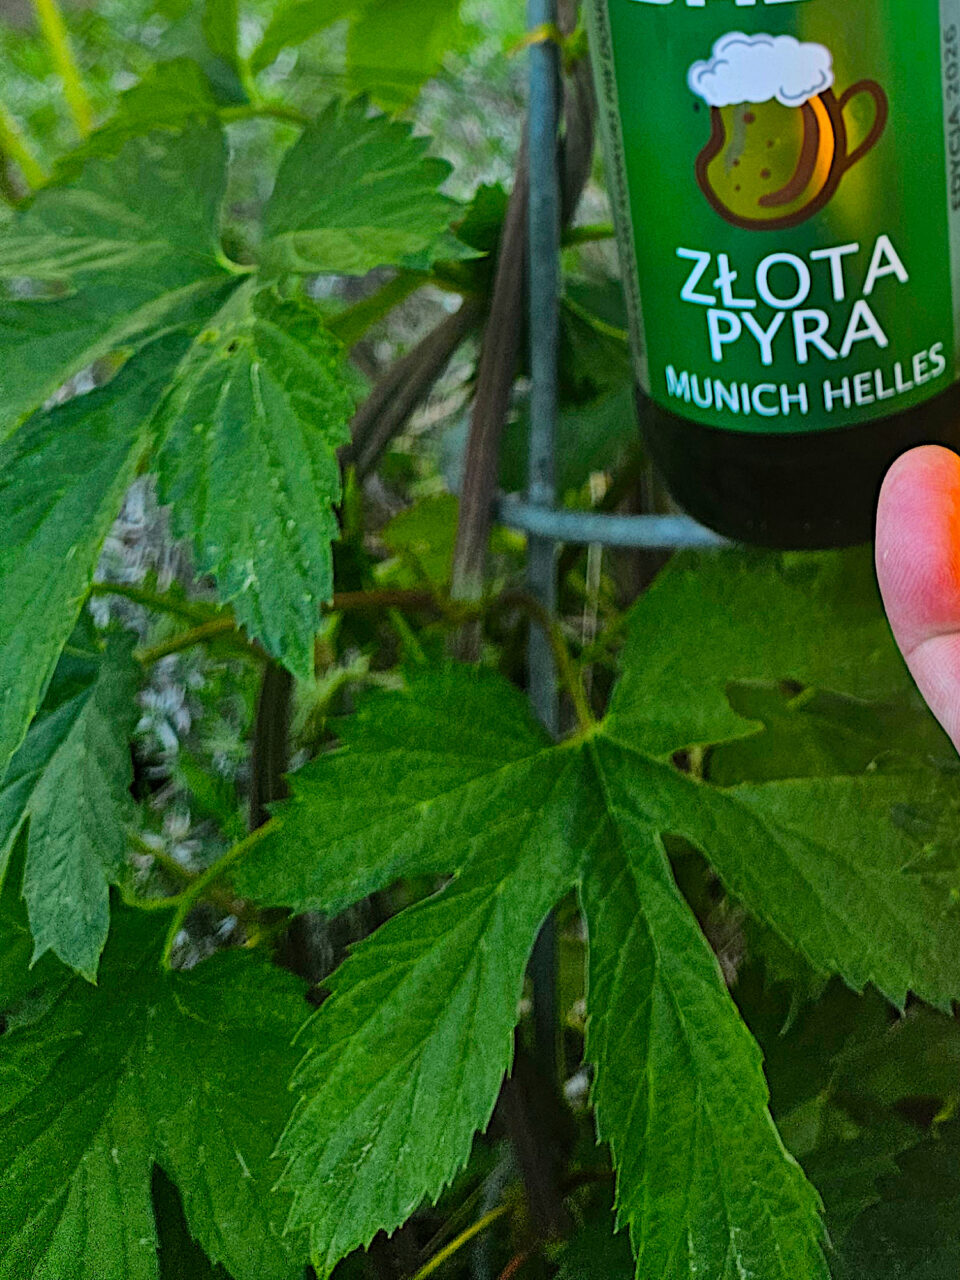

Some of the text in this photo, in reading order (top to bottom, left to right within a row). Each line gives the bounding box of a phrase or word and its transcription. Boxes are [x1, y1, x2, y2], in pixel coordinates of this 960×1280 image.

[943, 23, 960, 101] 2026
[676, 234, 909, 310] ZŁOTA
[707, 300, 889, 365] PYRA
[665, 342, 946, 416] MUNICH HELLES
